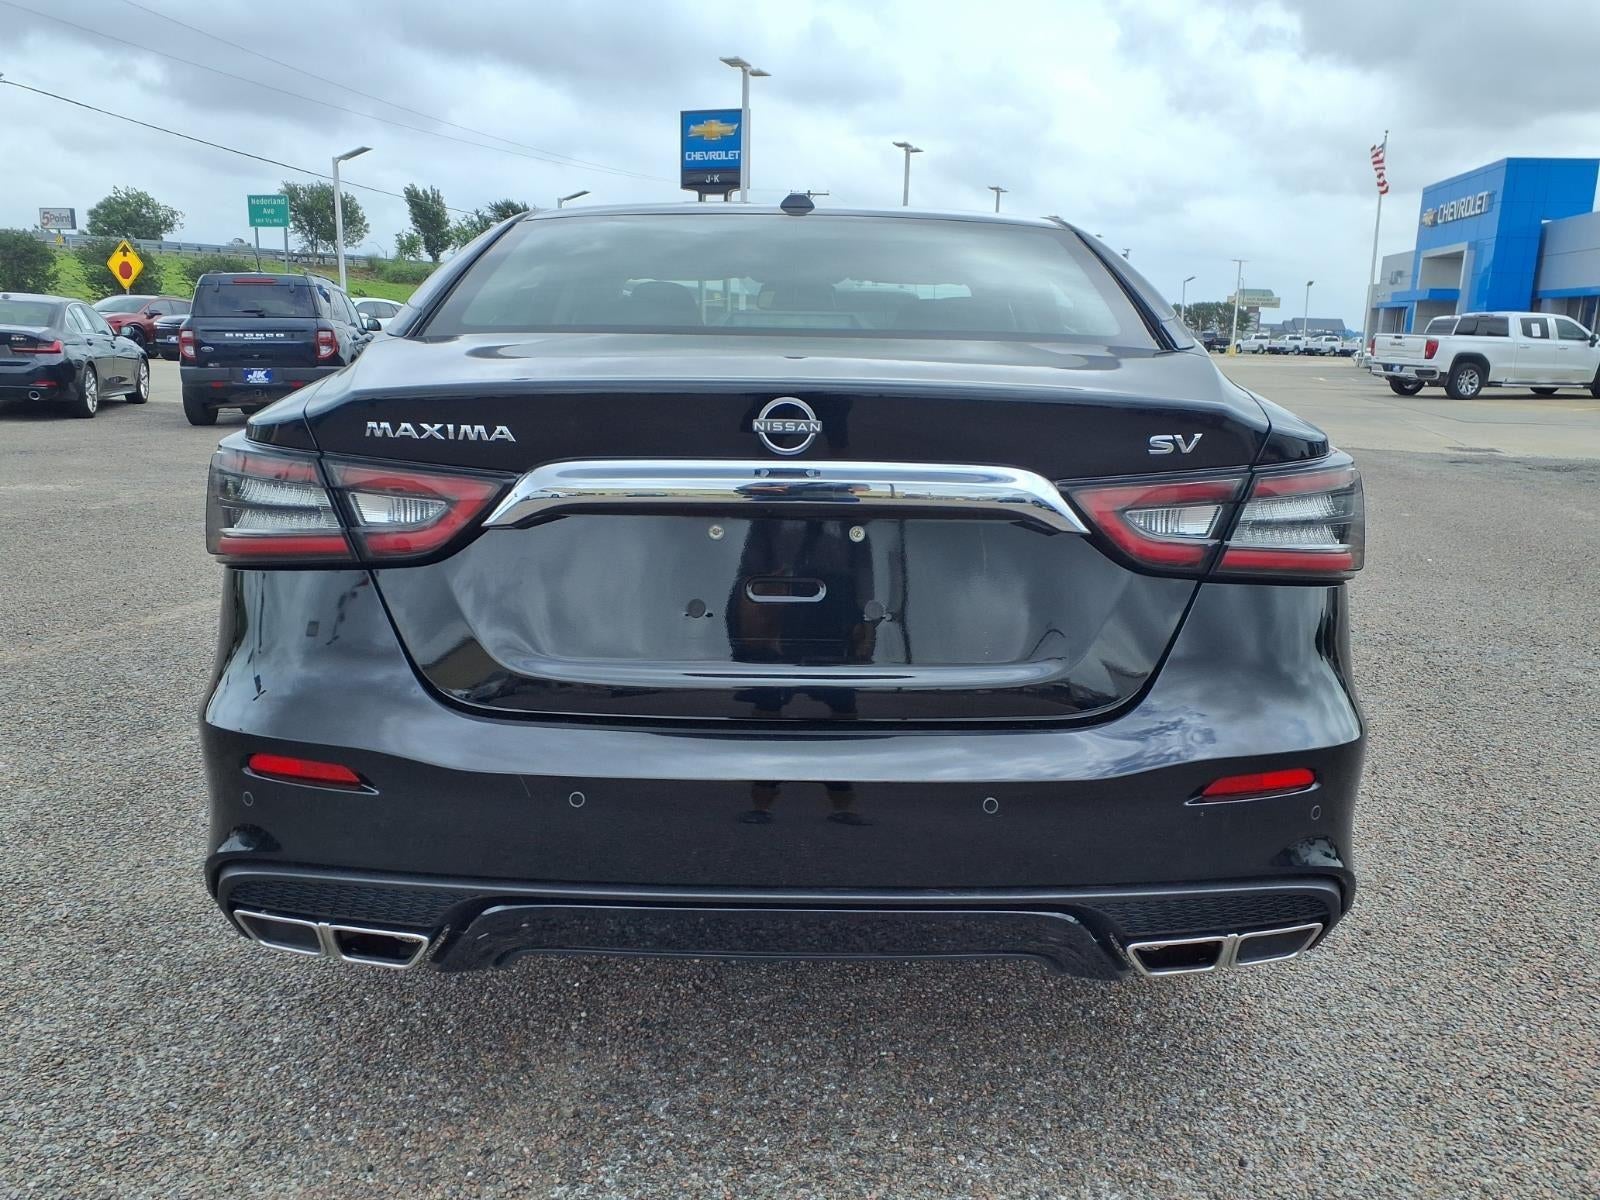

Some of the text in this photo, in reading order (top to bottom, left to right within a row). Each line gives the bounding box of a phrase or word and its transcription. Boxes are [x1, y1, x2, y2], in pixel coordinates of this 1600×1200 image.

[685, 150, 741, 161] CHEVROLET
[250, 197, 286, 205] Nederland
[262, 207, 275, 215] Ave
[1437, 191, 1489, 224] CHEVROLET
[365, 421, 517, 442] MAXIMA
[753, 421, 821, 432] NISSAN
[1148, 433, 1203, 455] SV
